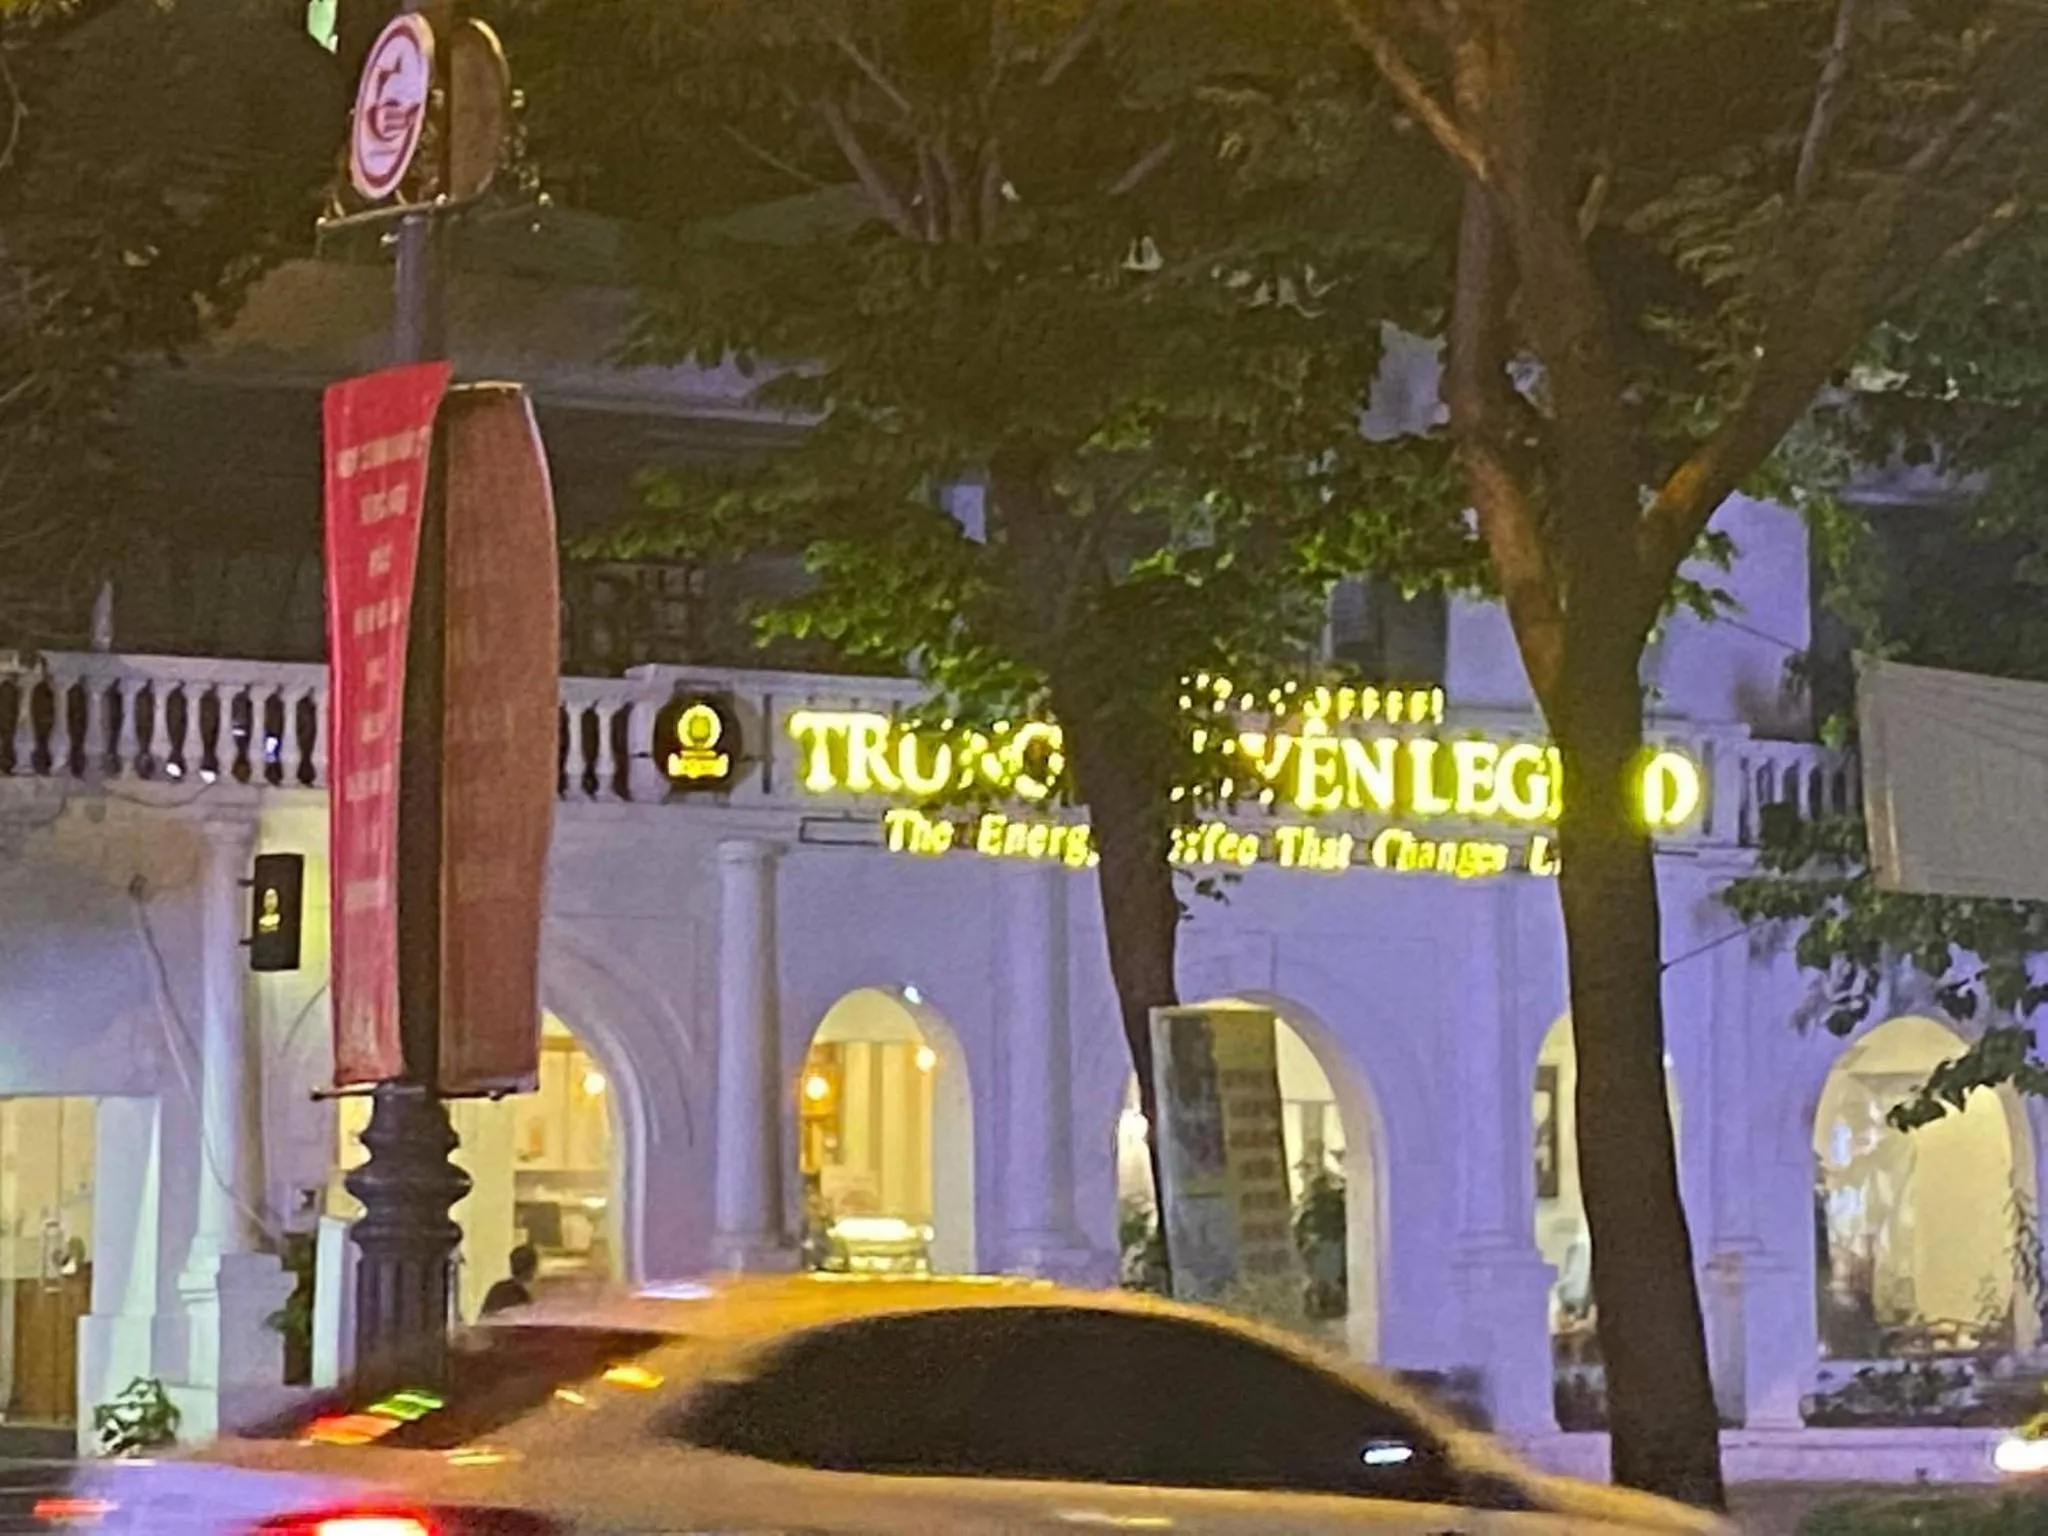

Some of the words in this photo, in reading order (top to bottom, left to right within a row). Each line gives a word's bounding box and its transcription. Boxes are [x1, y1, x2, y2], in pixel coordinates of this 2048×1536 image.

[1406, 737, 1701, 828] LEGD
[884, 808, 955, 854] The
[977, 813, 1100, 867] Energ
[1275, 825, 1354, 871] That
[1371, 827, 1509, 879] Changes
